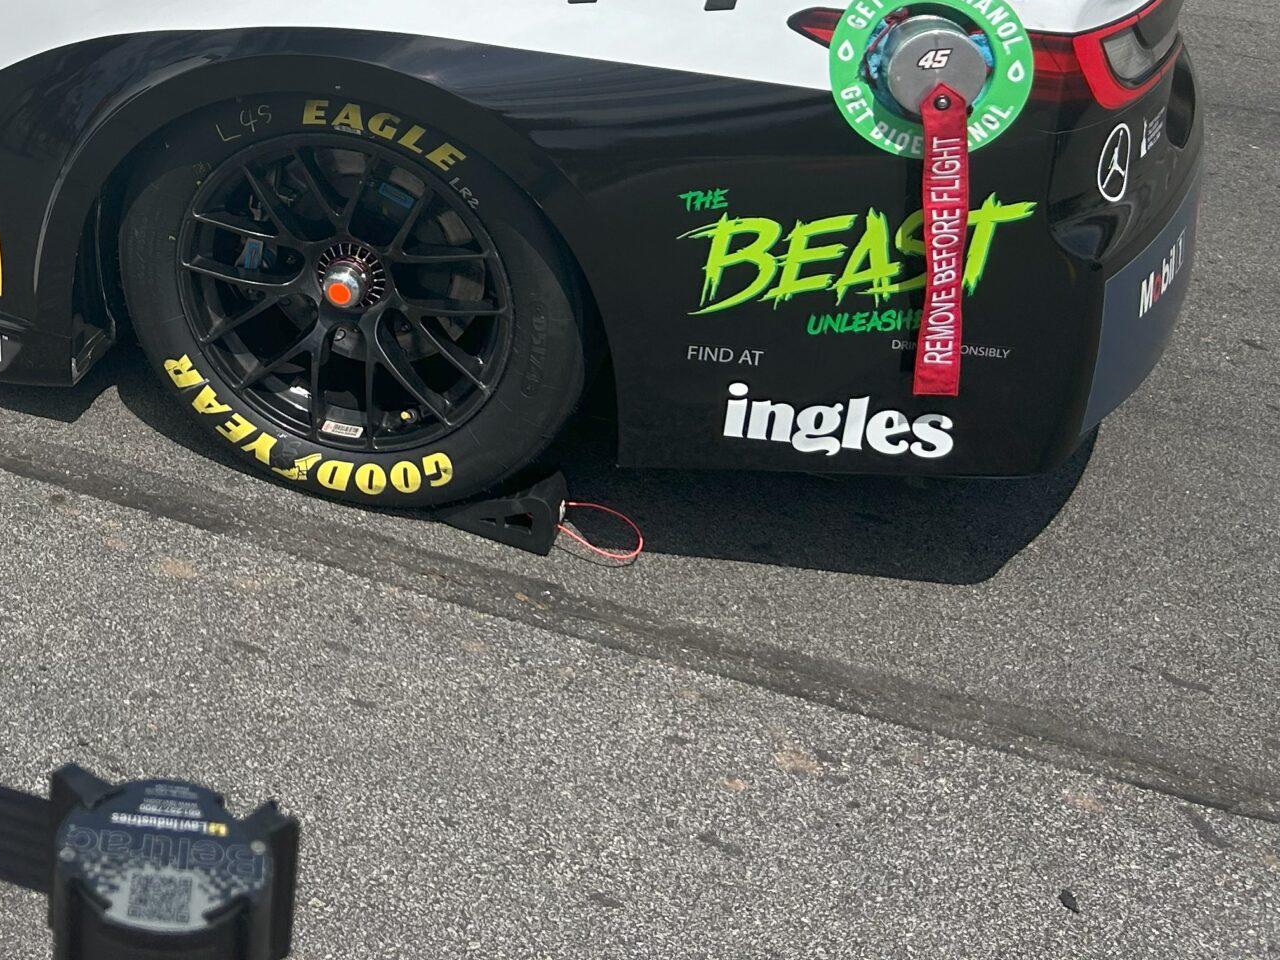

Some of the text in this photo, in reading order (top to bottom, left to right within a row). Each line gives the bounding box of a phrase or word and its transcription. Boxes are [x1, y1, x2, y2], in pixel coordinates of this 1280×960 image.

[917, 48, 954, 70] 45
[840, 84, 1015, 156] GET BIOENOL
[302, 99, 468, 172] EAGLE
[448, 176, 480, 210] LR2
[677, 188, 730, 211] THE
[923, 136, 961, 366] REMOVE BEFORE FLIGHT
[1138, 244, 1176, 319] Mobil
[807, 308, 923, 335] UNLEASHE
[687, 344, 765, 366] FIND AT
[960, 344, 1011, 359] ONSIBLY
[723, 382, 954, 459] ingles
[111, 811, 178, 830] Industries
